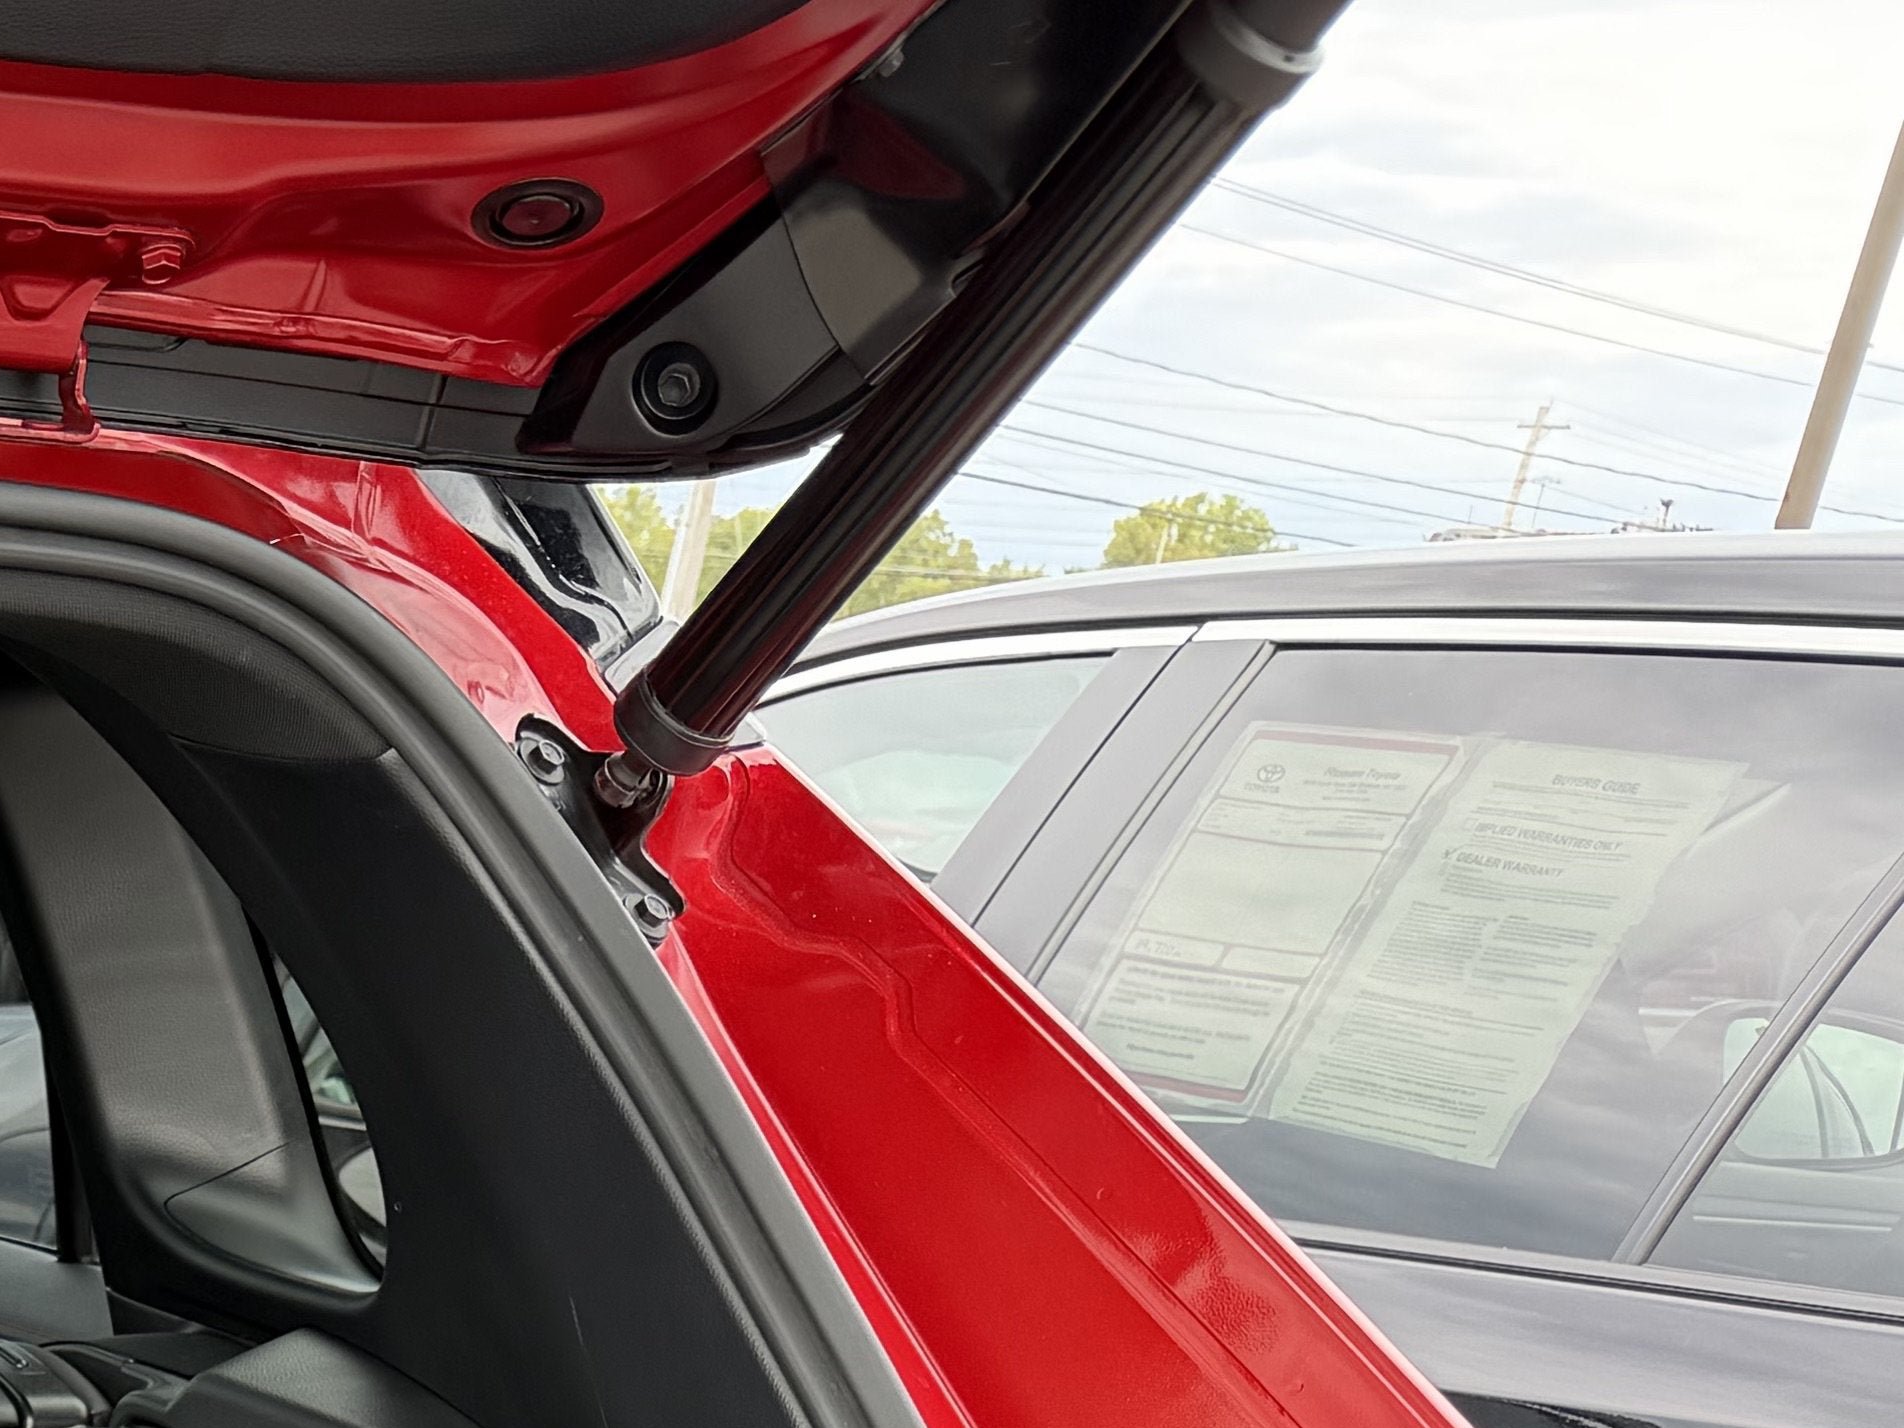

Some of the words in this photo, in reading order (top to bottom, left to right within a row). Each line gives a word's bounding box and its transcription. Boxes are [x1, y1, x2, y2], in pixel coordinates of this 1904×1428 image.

[1602, 778, 1641, 795] GUIDE
[1517, 824, 1594, 850] WARRANTIES
[1456, 850, 1501, 869] DEALER
[1502, 858, 1565, 878] WARRANTY
